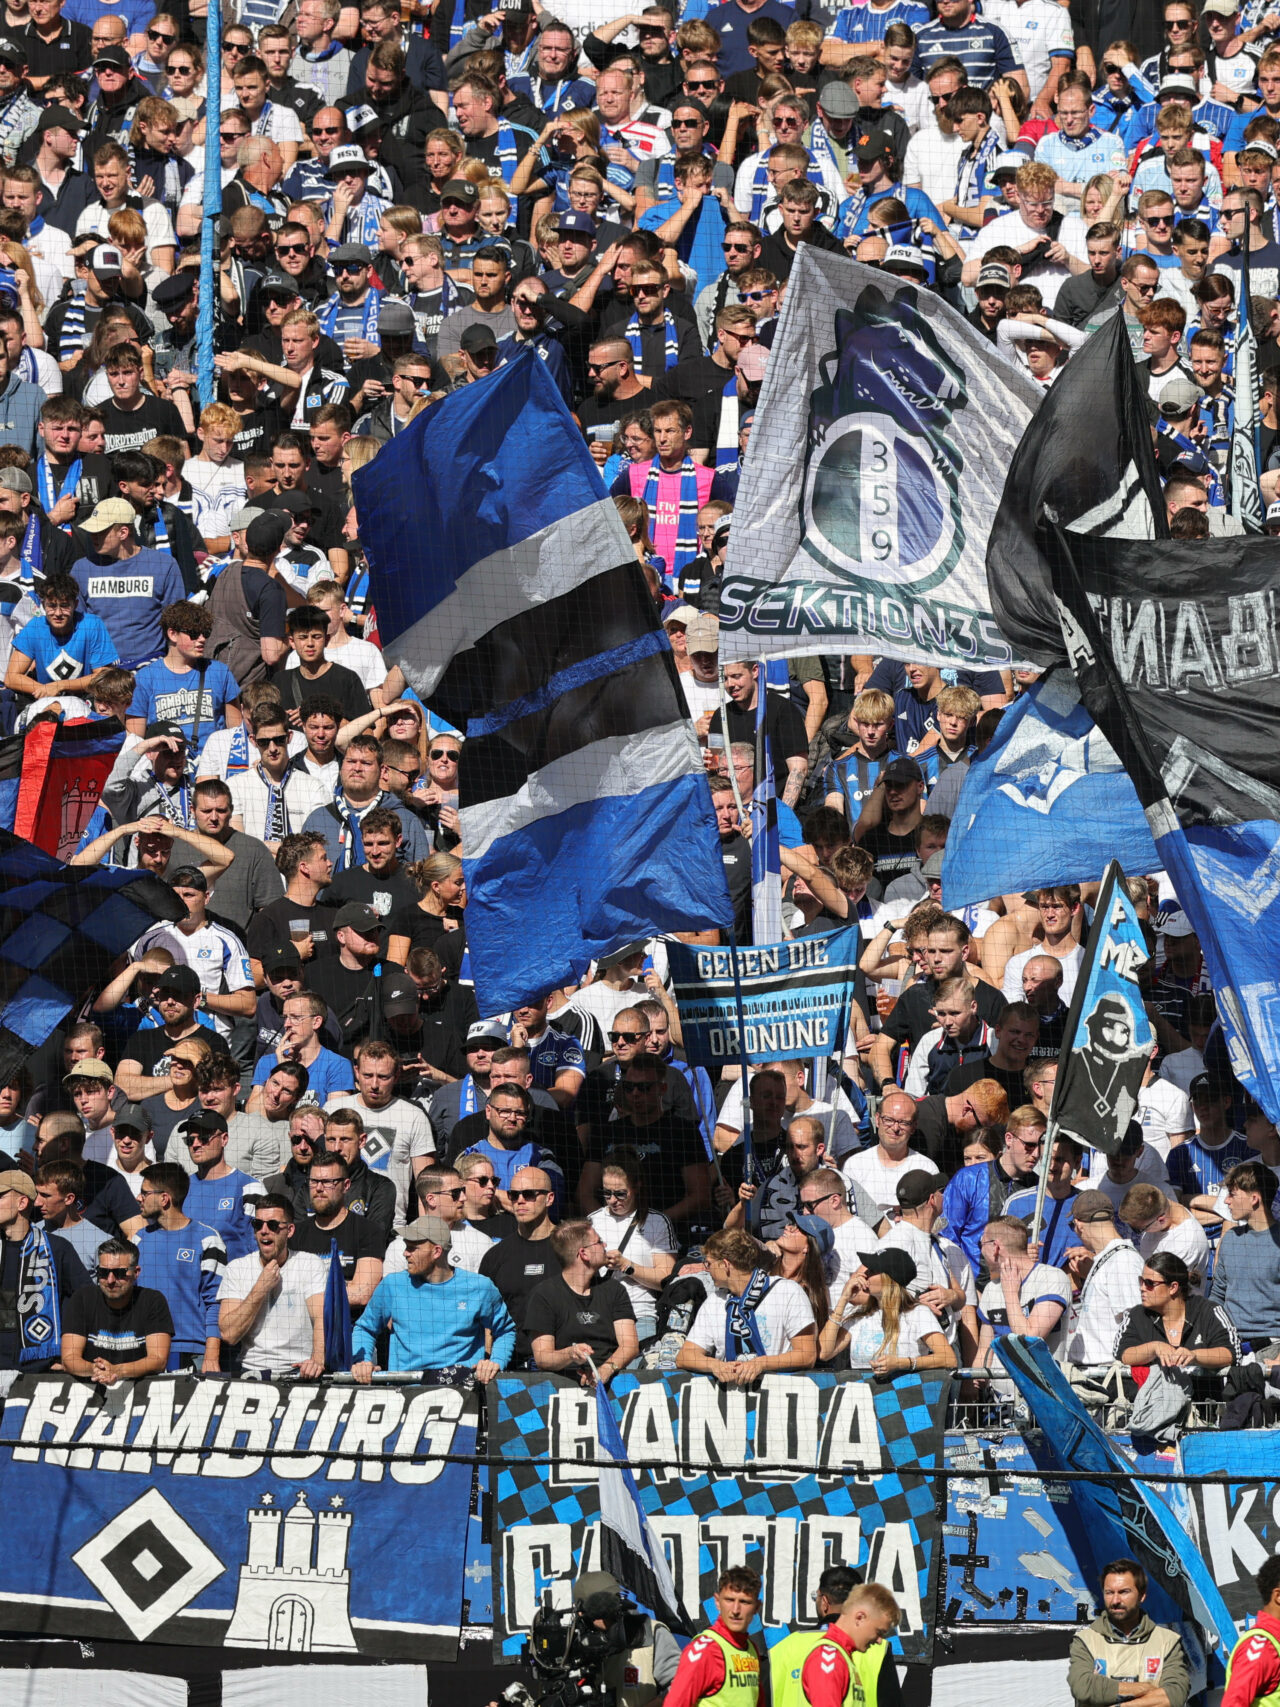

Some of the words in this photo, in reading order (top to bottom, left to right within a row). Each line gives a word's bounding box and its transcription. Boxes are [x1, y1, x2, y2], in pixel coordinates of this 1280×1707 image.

[658, 501, 677, 513] Fly
[89, 577, 150, 595] HAMBURG
[718, 580, 1013, 665] SEKTION35
[156, 702, 215, 721] SPORT-VEEIN
[697, 945, 780, 980] GEGEN
[787, 938, 830, 971] DIE
[708, 1016, 830, 1057] ORDNUNG
[11, 1378, 466, 1485] HAMBURG
[548, 1373, 884, 1487] BANDA
[502, 1514, 924, 1637] COTICA
